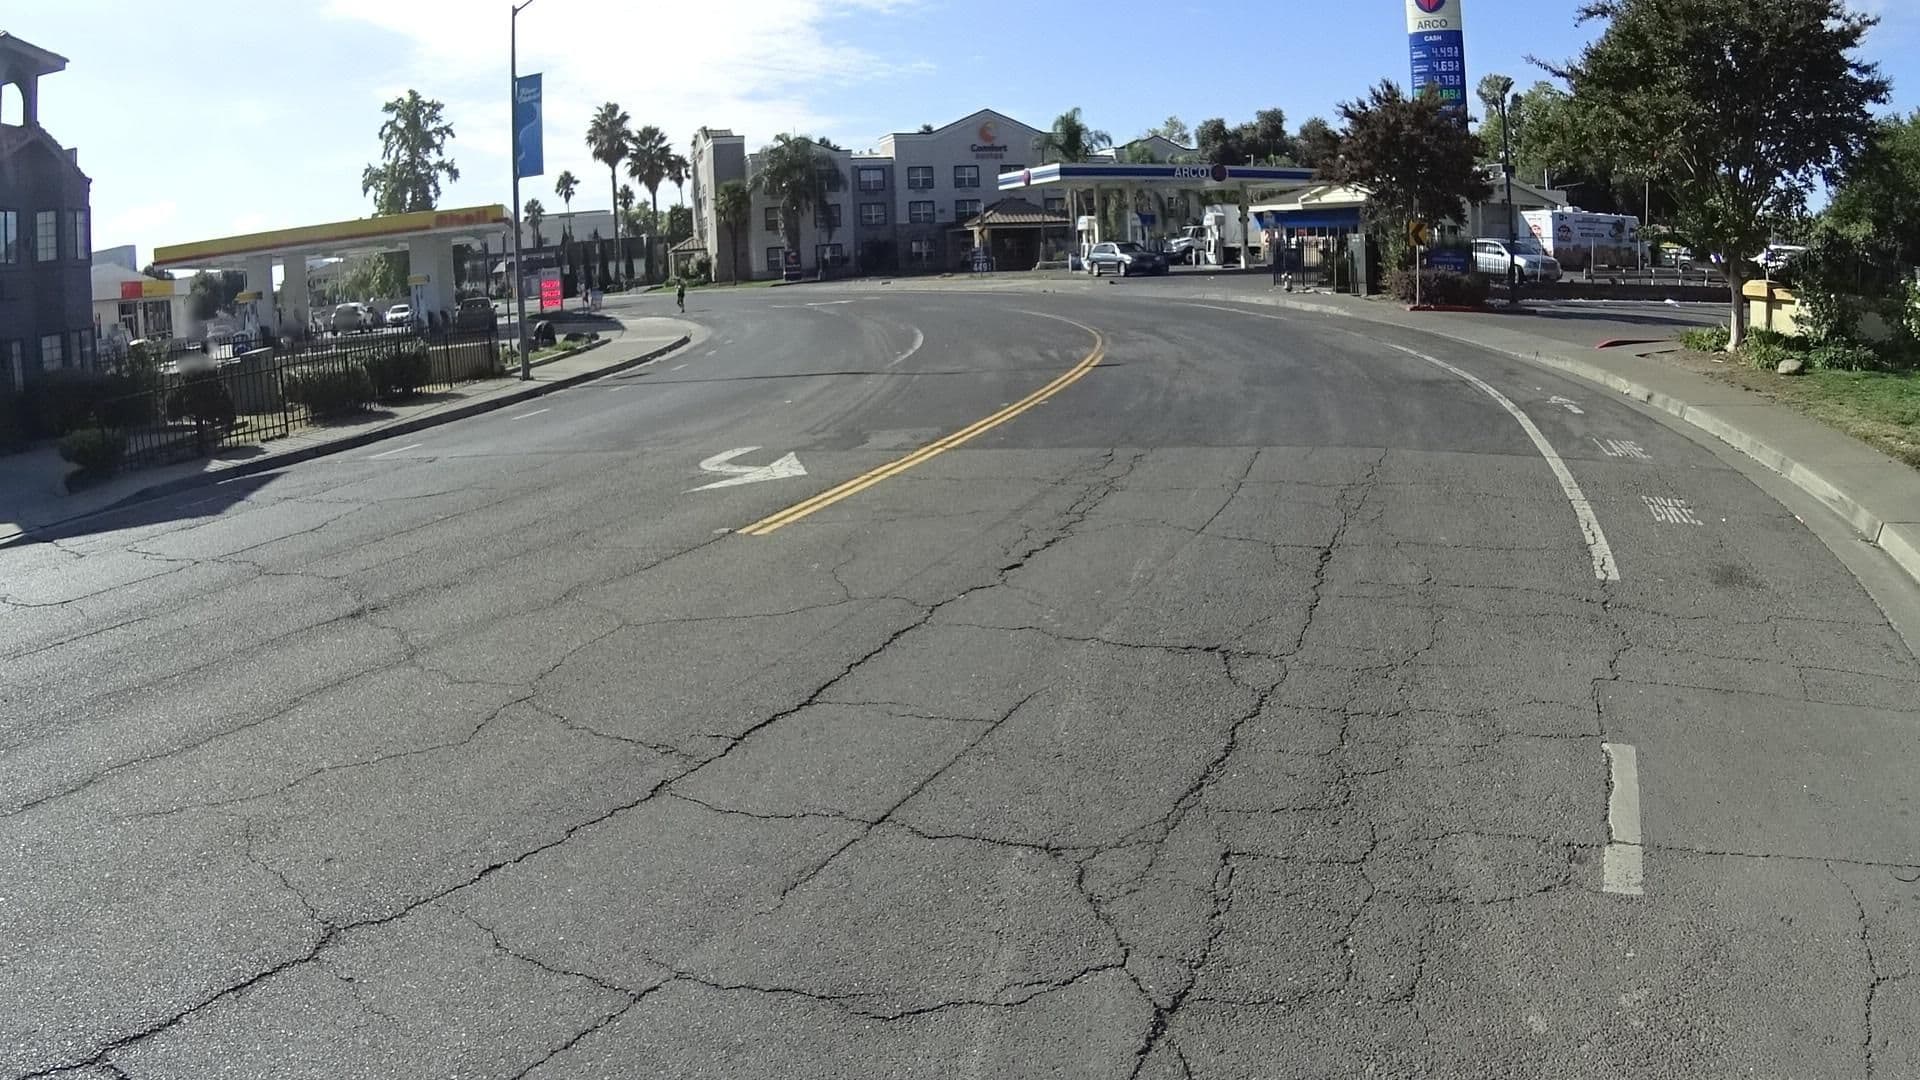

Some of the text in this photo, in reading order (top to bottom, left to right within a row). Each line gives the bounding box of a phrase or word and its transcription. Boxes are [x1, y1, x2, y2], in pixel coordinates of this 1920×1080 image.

[1417, 19, 1447, 30] ARCO
[970, 143, 1008, 153] Comfort
[1174, 166, 1207, 178] ARCO
